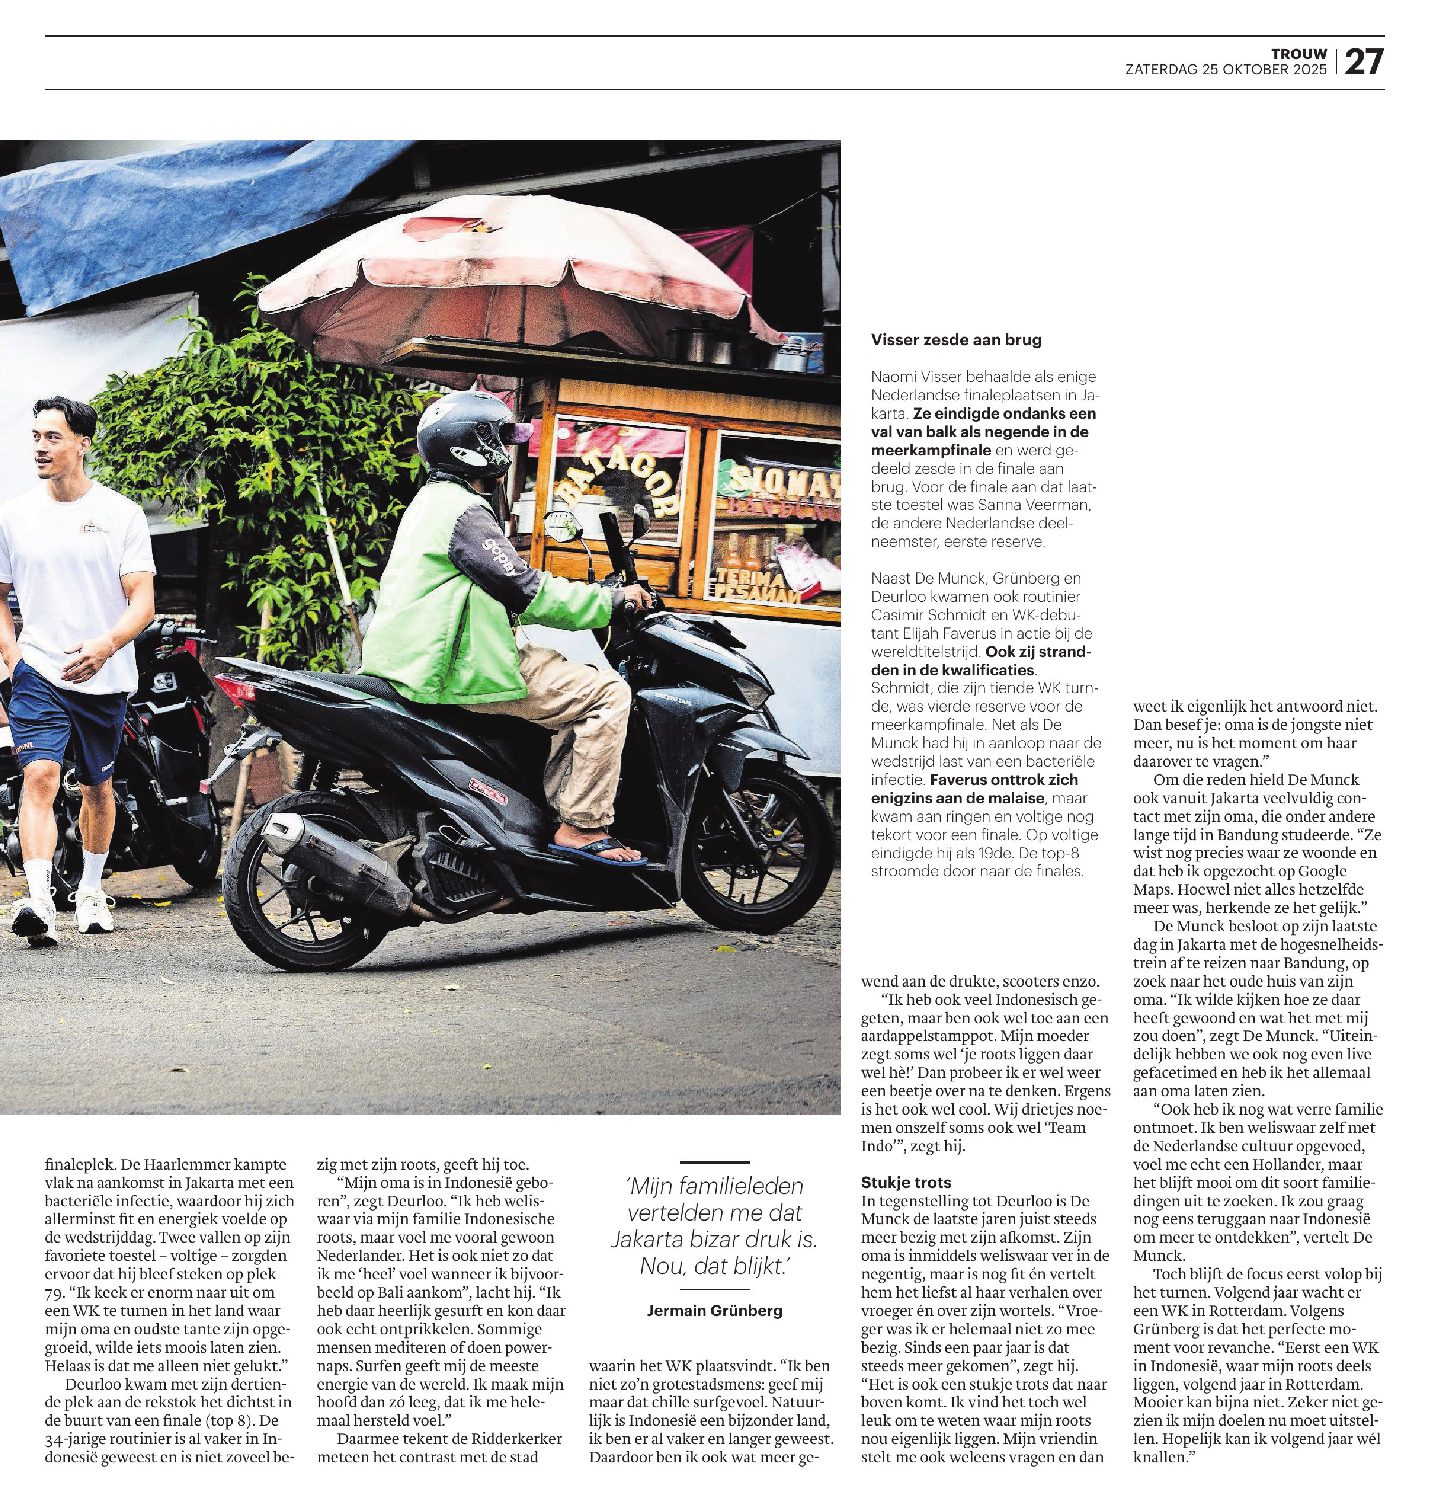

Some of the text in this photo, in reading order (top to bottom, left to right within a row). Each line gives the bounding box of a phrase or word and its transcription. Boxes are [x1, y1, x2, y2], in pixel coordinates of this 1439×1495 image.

[1271, 48, 1328, 60] TROUW
[1344, 47, 1385, 75] 27
[1125, 63, 1327, 75] ZATERDAG 25 OKTOBER 2025
[871, 332, 1042, 349] Visser zesde aan brug
[871, 369, 1097, 386] Naomi Visser behaalde als enige
[553, 443, 682, 518] BATAGOR
[715, 567, 786, 590] TERIMA
[679, 1175, 804, 1195] familieleden
[861, 1175, 952, 1192] Stukje trots
[628, 1202, 802, 1222] vertelden me dat
[610, 1228, 817, 1248] Jakarta bizar druk is.
[640, 1256, 687, 1277] Nou,
[694, 1255, 729, 1275] dat
[646, 1303, 783, 1320] Jermain Grünberg
